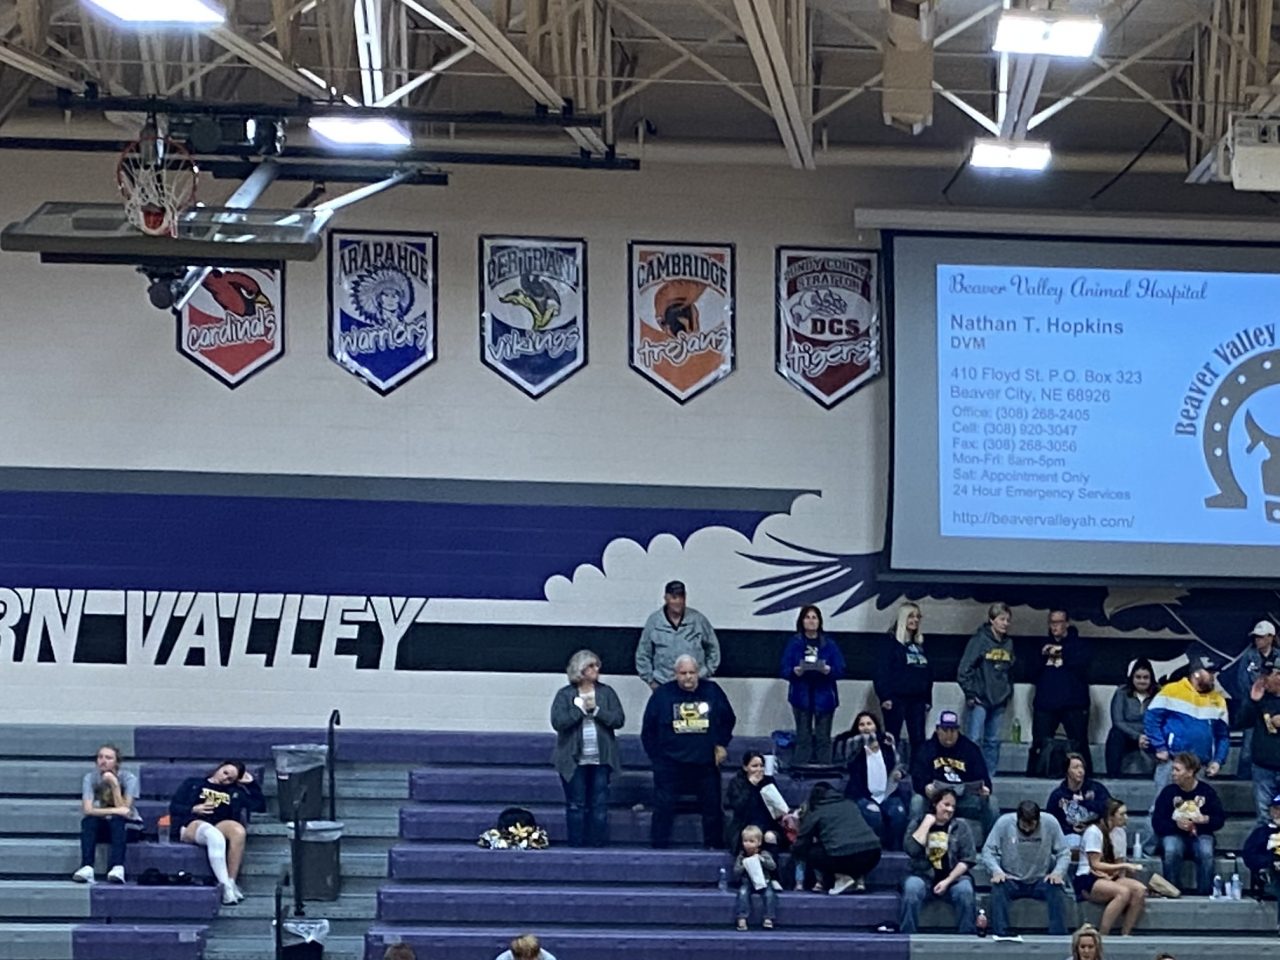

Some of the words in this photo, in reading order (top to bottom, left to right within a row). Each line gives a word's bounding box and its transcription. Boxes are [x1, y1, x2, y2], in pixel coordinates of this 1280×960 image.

[339, 240, 429, 287] ARAPAHOE
[636, 250, 729, 293] CAMBRIDGE
[949, 273, 1007, 296] Beaver
[1010, 274, 1064, 304] Valley
[1070, 276, 1132, 299] Animal
[1136, 277, 1209, 306] Hospital
[187, 307, 277, 352] cardinals
[339, 317, 428, 355] warriors
[811, 317, 861, 336] DCS
[950, 314, 1017, 333] Nathan
[1023, 316, 1041, 333] T.
[1047, 317, 1124, 337] Hopkins
[487, 326, 580, 361] vikings
[637, 327, 729, 368] trojans
[950, 336, 986, 349] DVM
[786, 336, 873, 378] tigers
[951, 367, 977, 381] 410
[982, 367, 1021, 383] Floyd
[1024, 368, 1043, 382] St.
[1049, 369, 1080, 383] P.O.
[1085, 370, 1112, 384] Box
[1116, 370, 1142, 384] 323
[1174, 361, 1221, 438] Beaver
[1213, 322, 1276, 366] Valley
[950, 386, 1001, 400] Beaver
[1004, 387, 1037, 402] City,
[1041, 388, 1063, 402] NE
[1067, 388, 1111, 403] 68926
[952, 405, 992, 419] Office:
[996, 406, 1029, 421] (308)
[1031, 407, 1090, 421] 268-2405
[983, 423, 1016, 437] (308)
[1020, 424, 1078, 437] 920-3047
[983, 438, 1016, 453] (308)
[1019, 439, 1077, 453] 268-3056
[980, 470, 1059, 486] Appointment
[1062, 472, 1090, 486] Only
[953, 485, 968, 497] 24
[972, 485, 1002, 497] Hour
[1006, 486, 1075, 501] Emergency
[1078, 488, 1132, 501] Services
[124, 589, 430, 671] VALLEY
